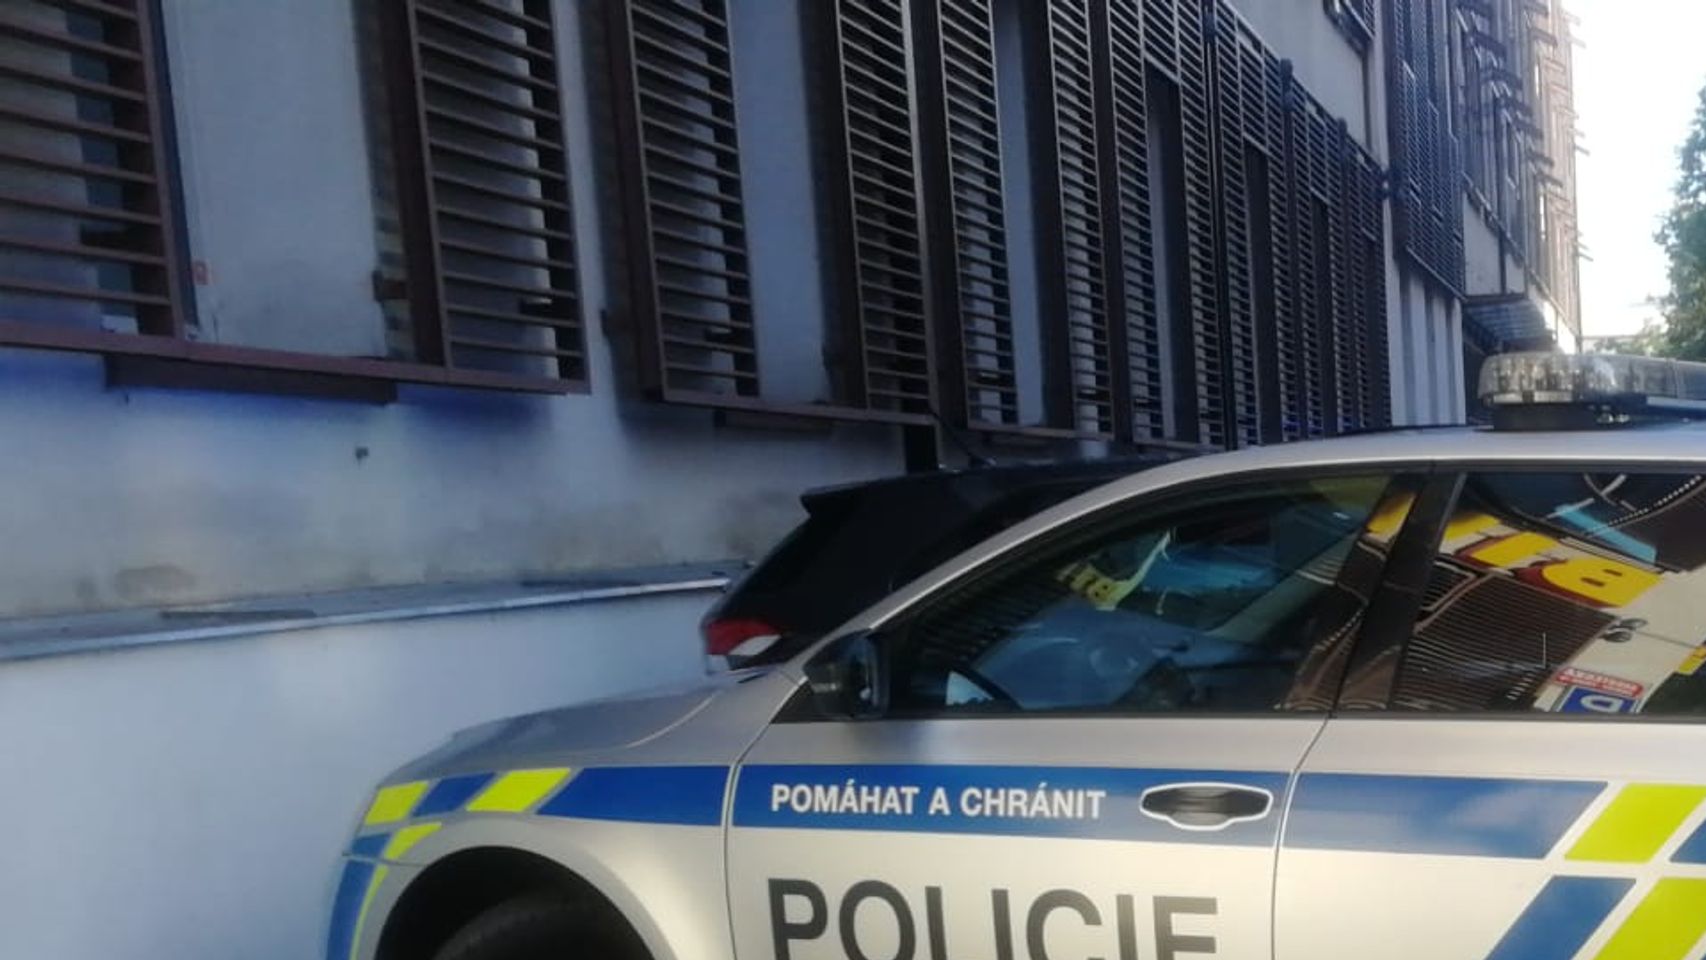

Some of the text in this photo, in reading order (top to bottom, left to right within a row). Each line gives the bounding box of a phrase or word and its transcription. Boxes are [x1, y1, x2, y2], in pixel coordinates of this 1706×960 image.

[770, 779, 1107, 820] POMÁHAT A CHRÁNIT
